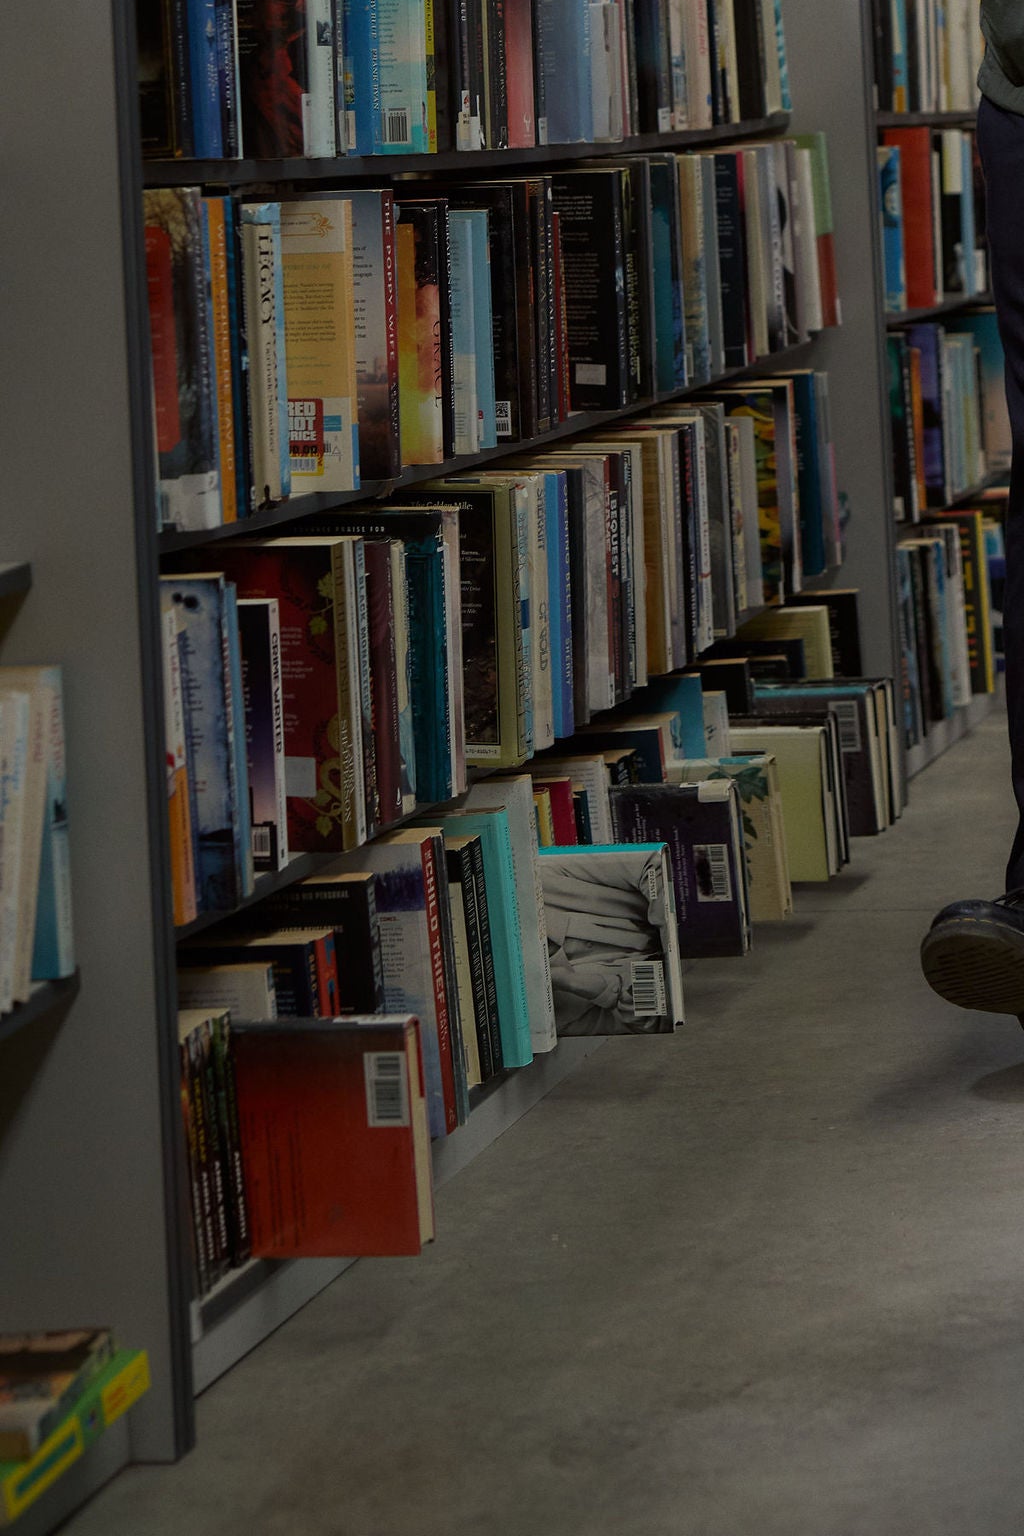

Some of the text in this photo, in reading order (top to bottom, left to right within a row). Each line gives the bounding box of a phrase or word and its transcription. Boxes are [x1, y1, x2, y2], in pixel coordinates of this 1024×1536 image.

[217, 223, 225, 279] WHAT
[258, 235, 272, 325] LEGACY
[220, 288, 228, 362] COULD
[223, 369, 230, 395] BE
[288, 401, 316, 416] RED
[225, 401, 234, 471] SAVED
[289, 431, 317, 441] RICE
[563, 483, 571, 564] OPENING
[610, 498, 618, 576] BEQUEST
[360, 630, 369, 711] MONASTERY
[540, 631, 549, 671] GOLD
[272, 632, 282, 753] CRIME WRITER
[315, 890, 349, 899] PERSONAL
[463, 850, 472, 889] DENNIS
[426, 861, 444, 1004] CHILD THIEF
[467, 893, 475, 925] SMITH
[472, 952, 480, 977] SONG
[477, 1001, 486, 1029] MARY
[194, 1077, 203, 1125] DEATH
[197, 1128, 206, 1163] TRAP
[202, 1171, 214, 1260] ANNA SMITH
[214, 1160, 227, 1248] ANNA SMITH
[234, 1151, 247, 1239] ANNA SMITH
